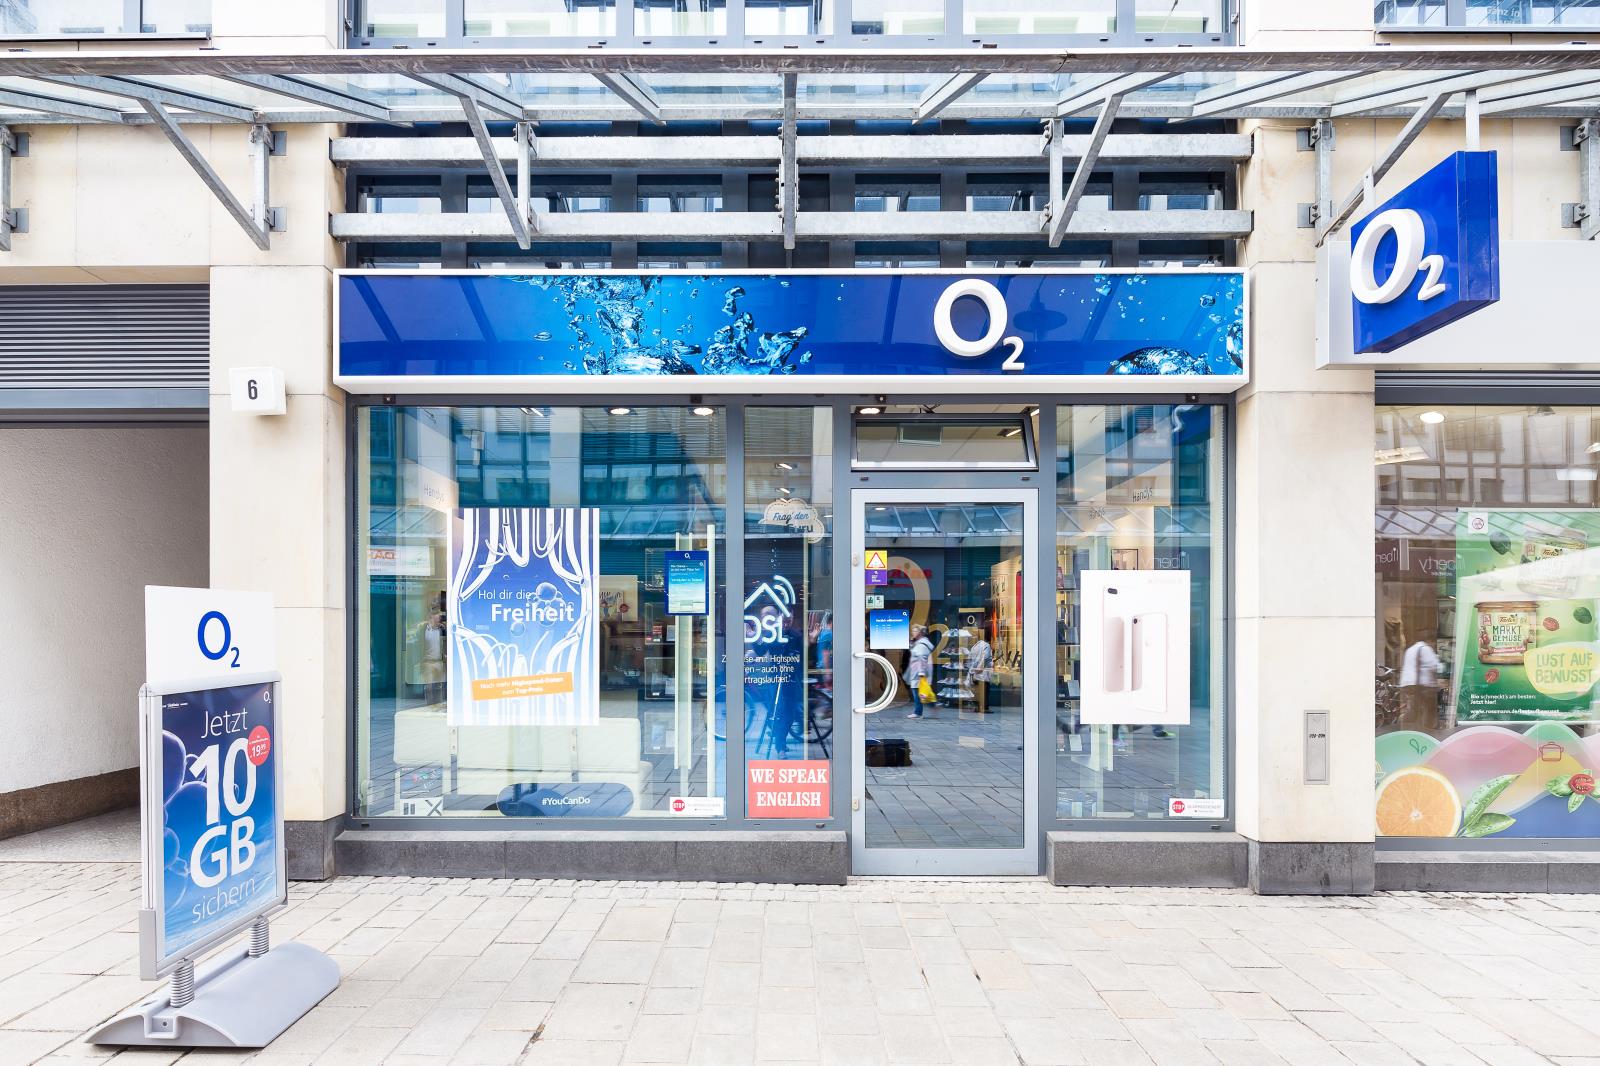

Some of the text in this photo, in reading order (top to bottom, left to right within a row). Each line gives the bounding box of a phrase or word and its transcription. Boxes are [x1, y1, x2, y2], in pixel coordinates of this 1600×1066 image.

[247, 379, 258, 400] 6
[478, 590, 531, 600] Hol dir die
[491, 603, 574, 622] Freiheit
[744, 615, 789, 643] DSL
[1492, 625, 1521, 635] MARKT
[1537, 652, 1593, 668] LUST AUF
[779, 665, 795, 673] ohne
[1535, 669, 1593, 684] BEWUSST
[201, 707, 248, 739] Jetzt
[189, 737, 257, 826] 10
[750, 768, 828, 784] WE SPEAK
[541, 796, 591, 806] #YouCanDo
[756, 791, 821, 807] ENGLISH
[190, 816, 257, 888] GB
[192, 877, 255, 923] sichern
